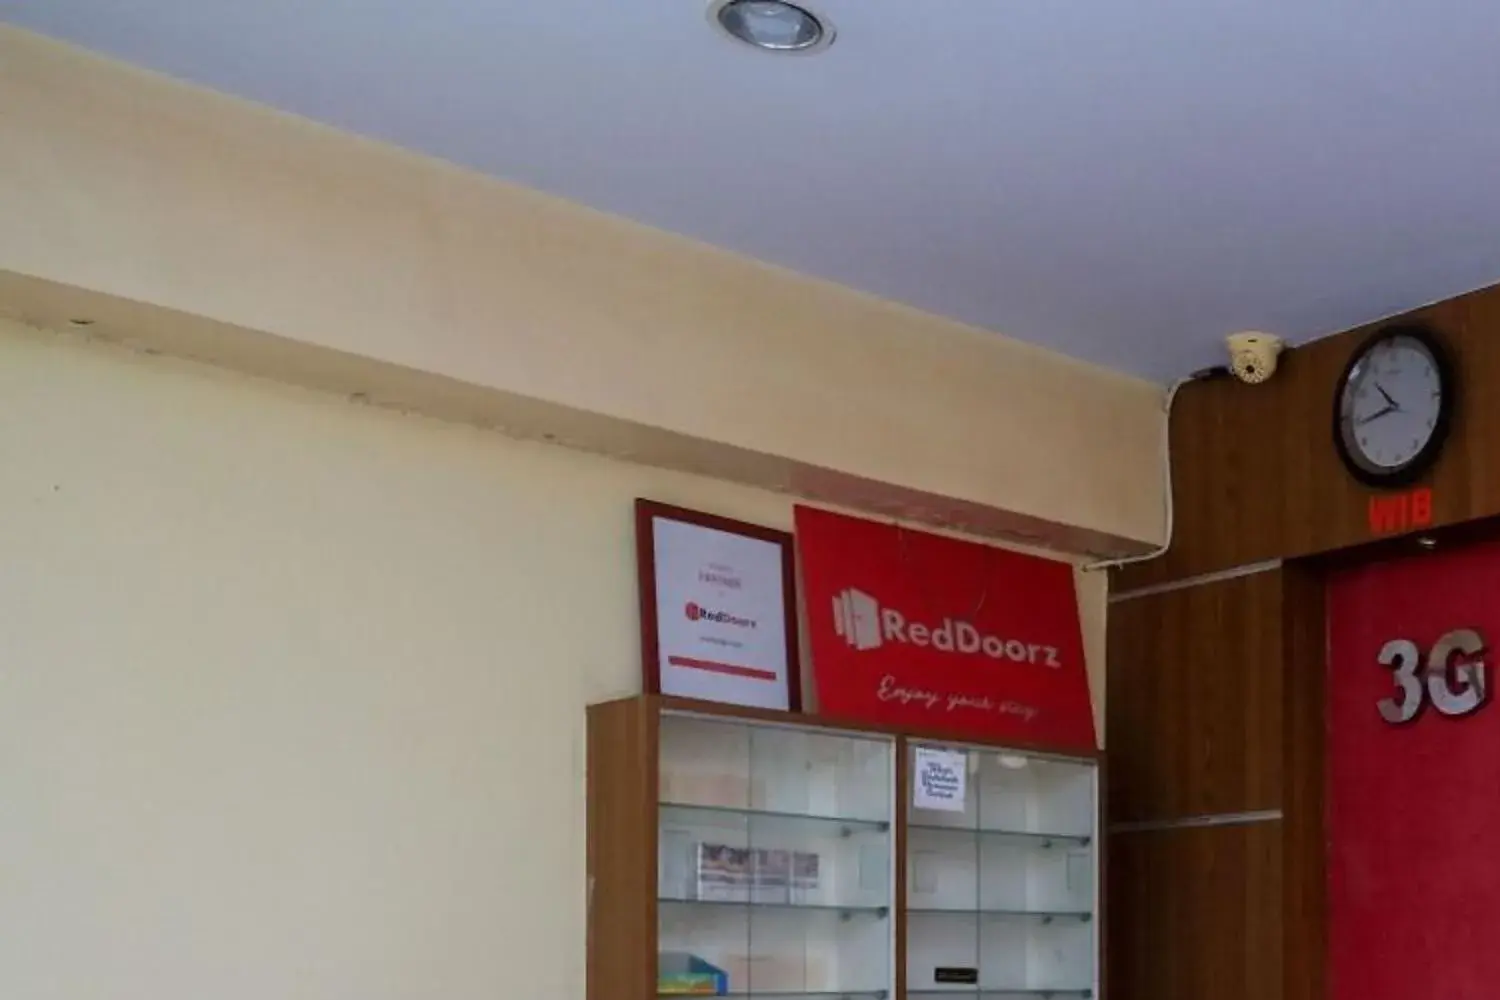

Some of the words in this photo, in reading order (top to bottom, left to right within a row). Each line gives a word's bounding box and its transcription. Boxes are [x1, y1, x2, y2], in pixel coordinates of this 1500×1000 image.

[1368, 488, 1433, 534] WIB
[881, 608, 1062, 669] RedDoorz
[877, 675, 940, 708] Enjoy
[1376, 629, 1486, 723] 3G
